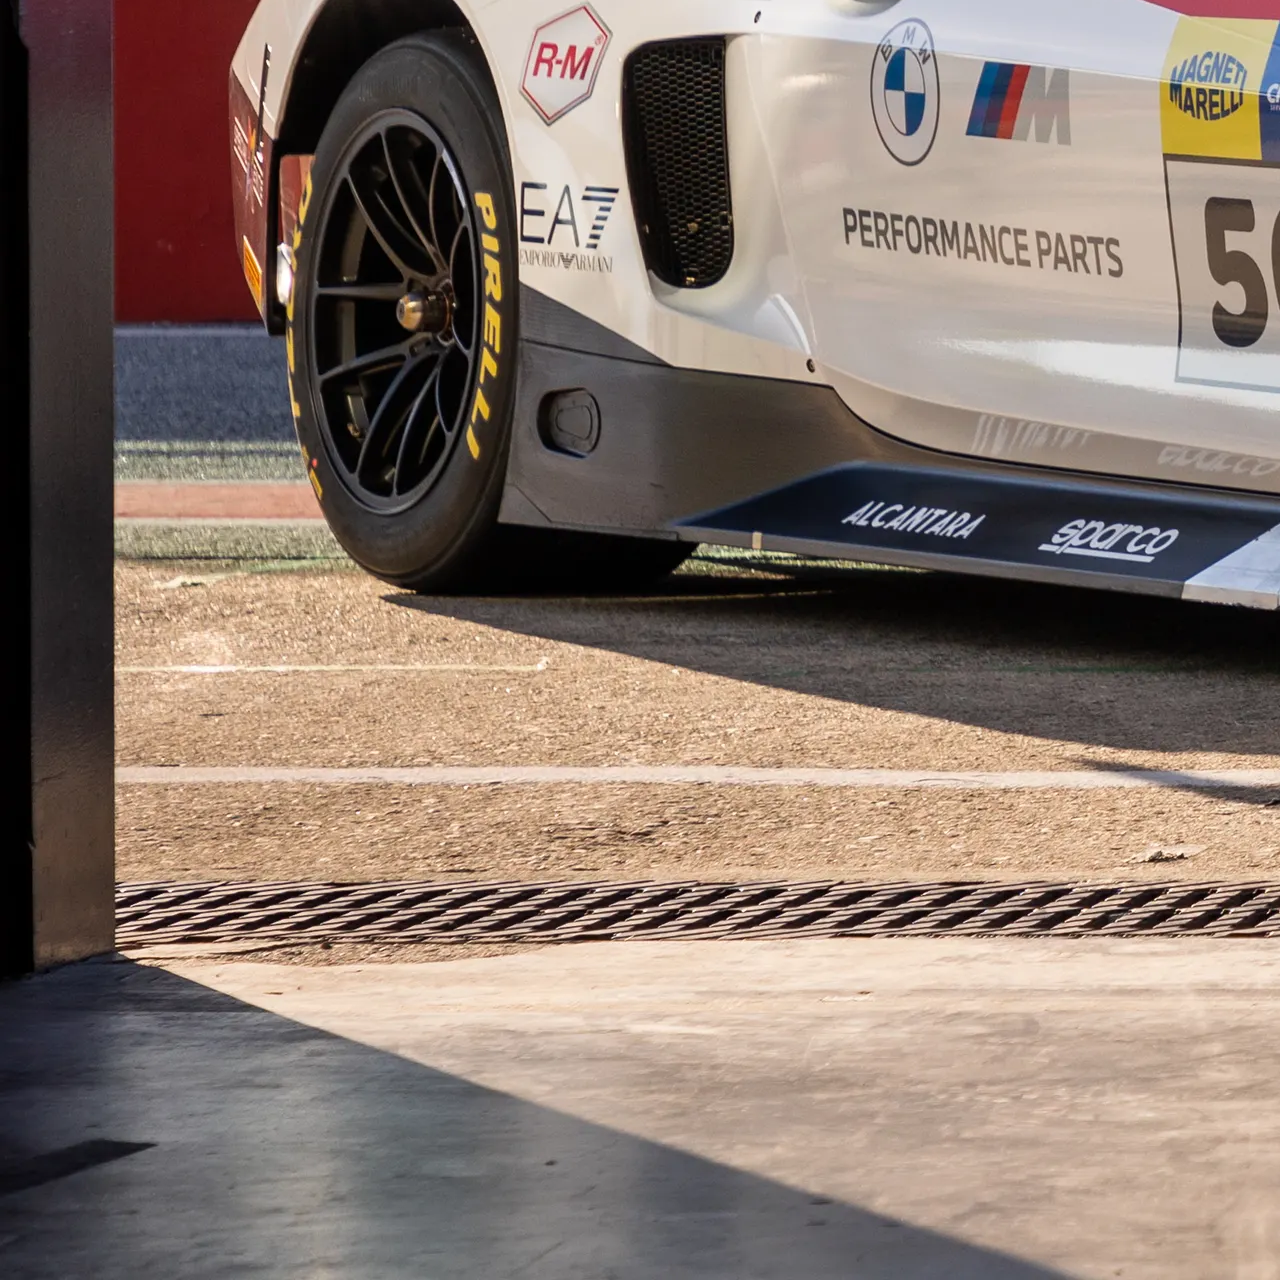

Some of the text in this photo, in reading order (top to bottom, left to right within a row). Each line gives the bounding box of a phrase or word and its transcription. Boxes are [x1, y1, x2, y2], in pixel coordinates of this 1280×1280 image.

[880, 26, 931, 65] BMW
[1170, 51, 1248, 86] MAGNETI
[1170, 82, 1245, 122] MARELLI
[519, 181, 619, 250] EA7
[842, 207, 1124, 279] PERFORMANCE PARTS
[466, 192, 502, 460] PIRELLI
[841, 500, 987, 540] ALCANTARA
[1044, 518, 1180, 559] sparco
